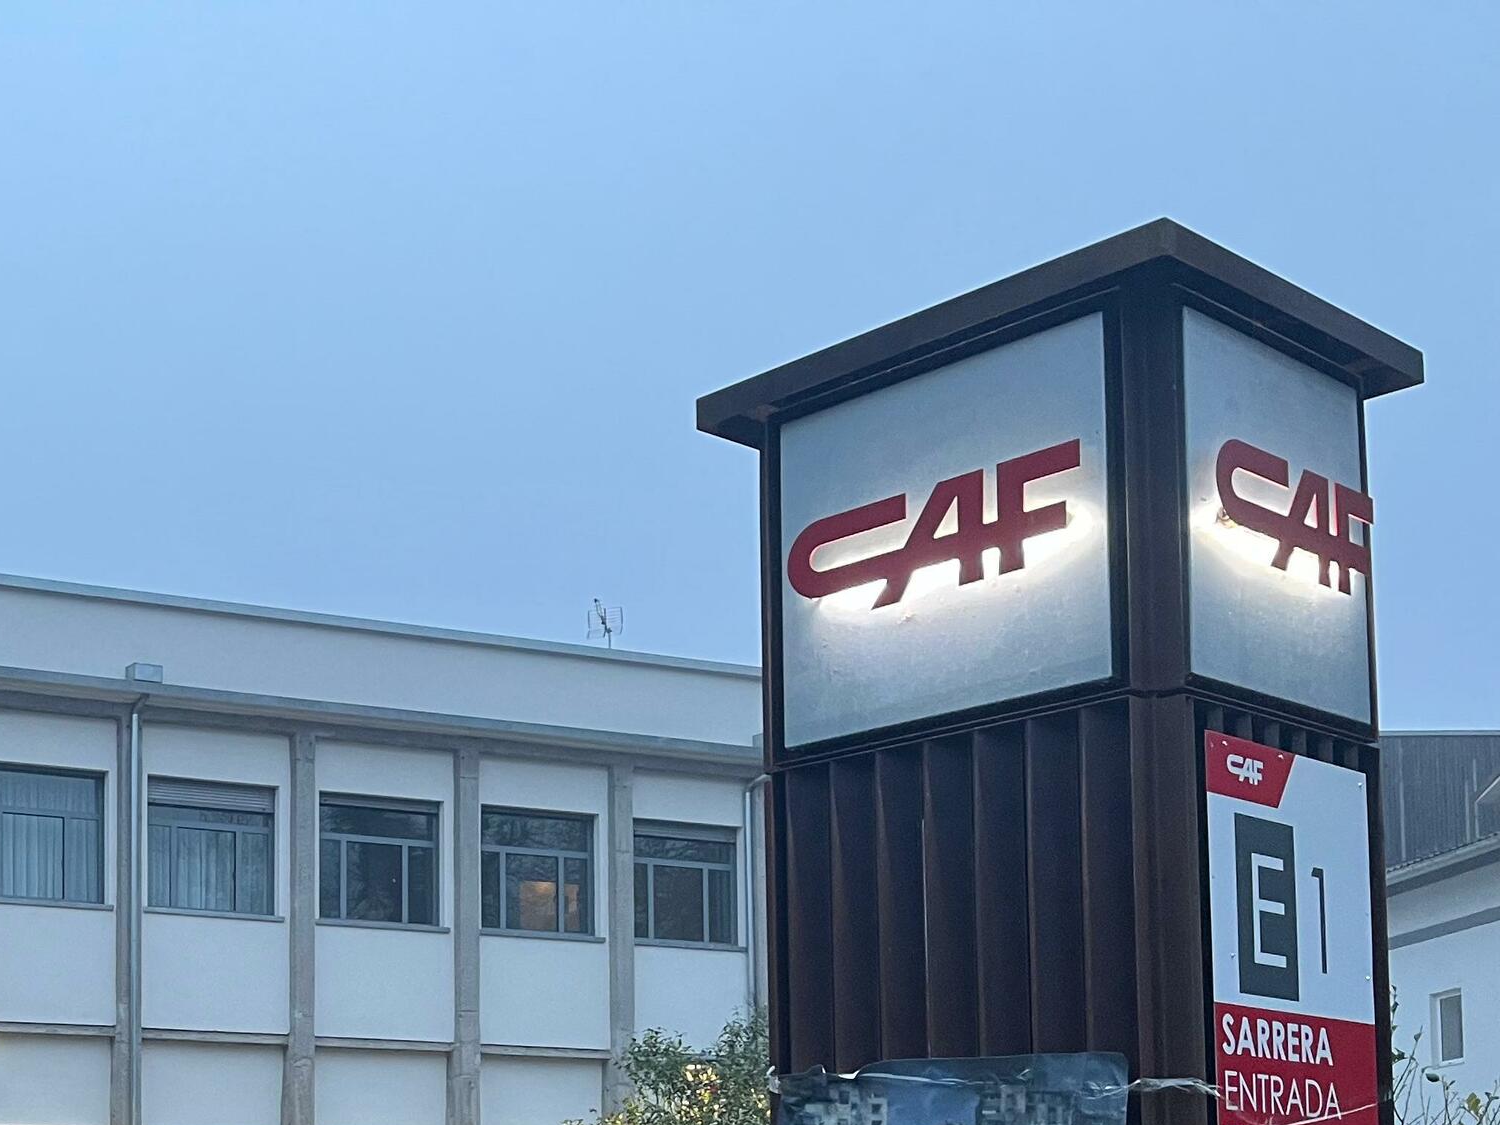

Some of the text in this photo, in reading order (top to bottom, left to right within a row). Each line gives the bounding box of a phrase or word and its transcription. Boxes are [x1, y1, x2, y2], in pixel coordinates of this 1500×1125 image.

[787, 439, 1081, 610] CAF
[1215, 439, 1374, 595] CAF
[1227, 754, 1264, 785] CAF
[1222, 1013, 1333, 1066] SARRERA
[1224, 1070, 1342, 1120] ENTRADA
